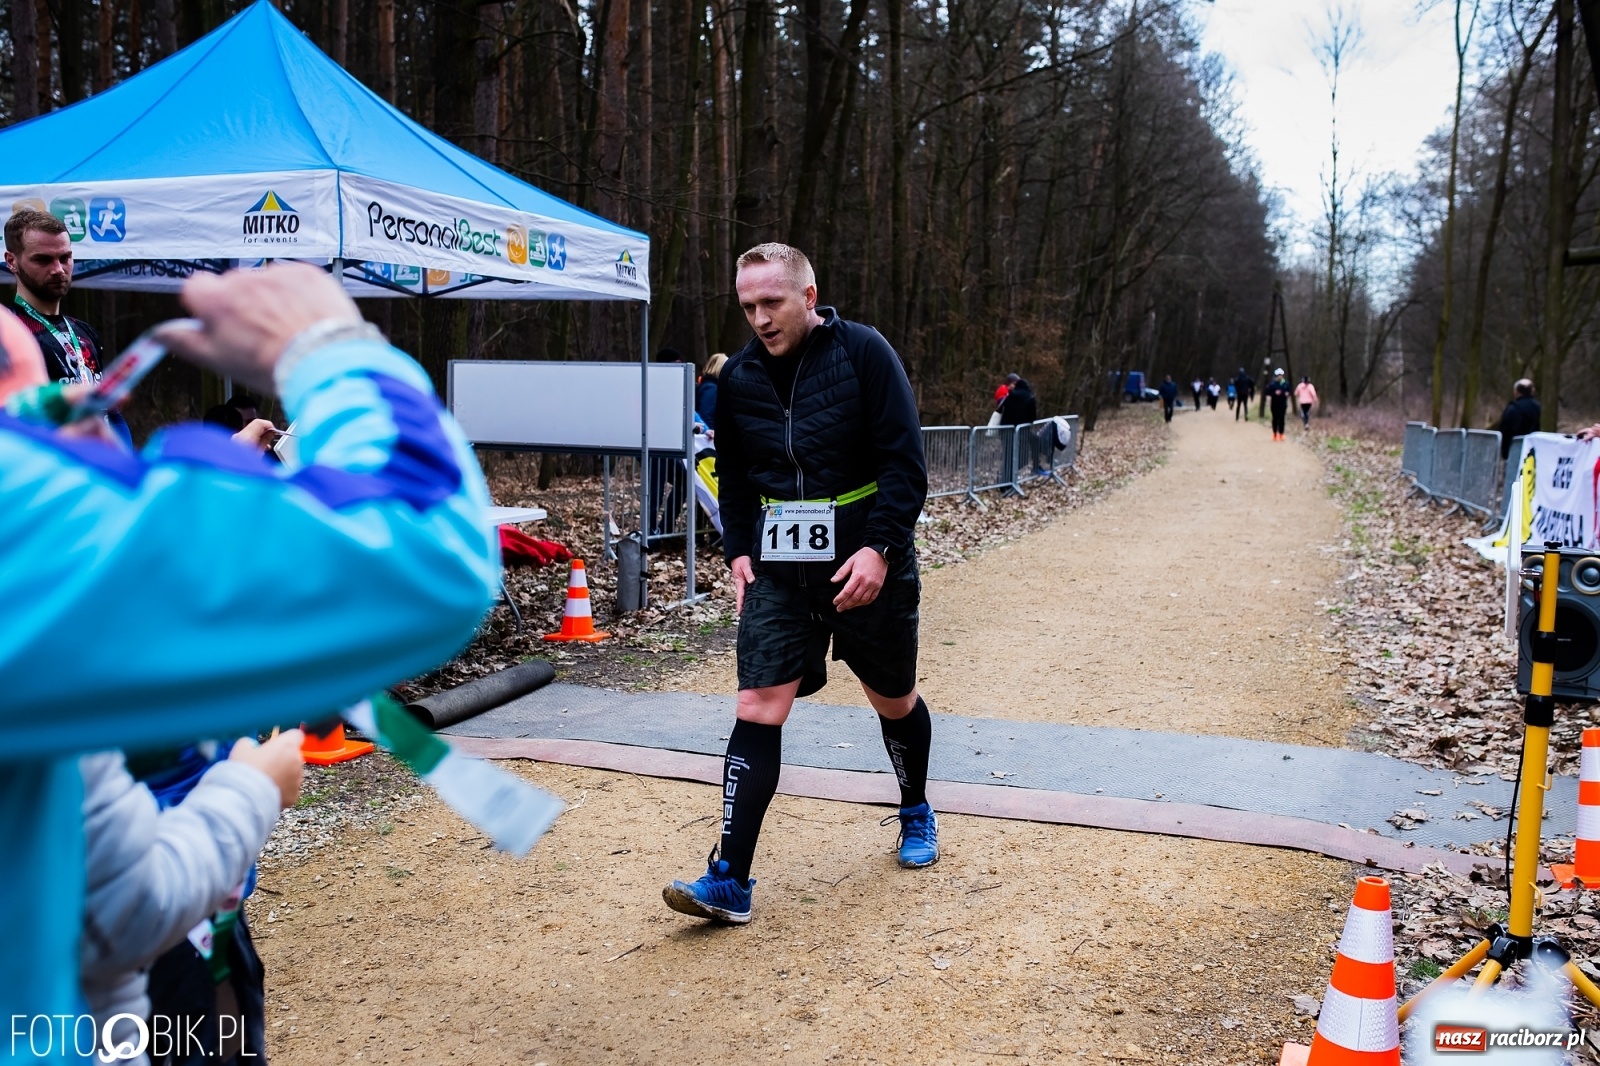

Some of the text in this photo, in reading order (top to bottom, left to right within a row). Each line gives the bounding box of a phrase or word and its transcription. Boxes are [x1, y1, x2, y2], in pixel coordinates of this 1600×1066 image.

[243, 214, 300, 235] MITKO
[243, 236, 298, 244] for events
[368, 201, 501, 257] PersonalBest
[767, 523, 830, 551] 118
[884, 735, 911, 788] kalenji
[721, 754, 750, 835] kalenji
